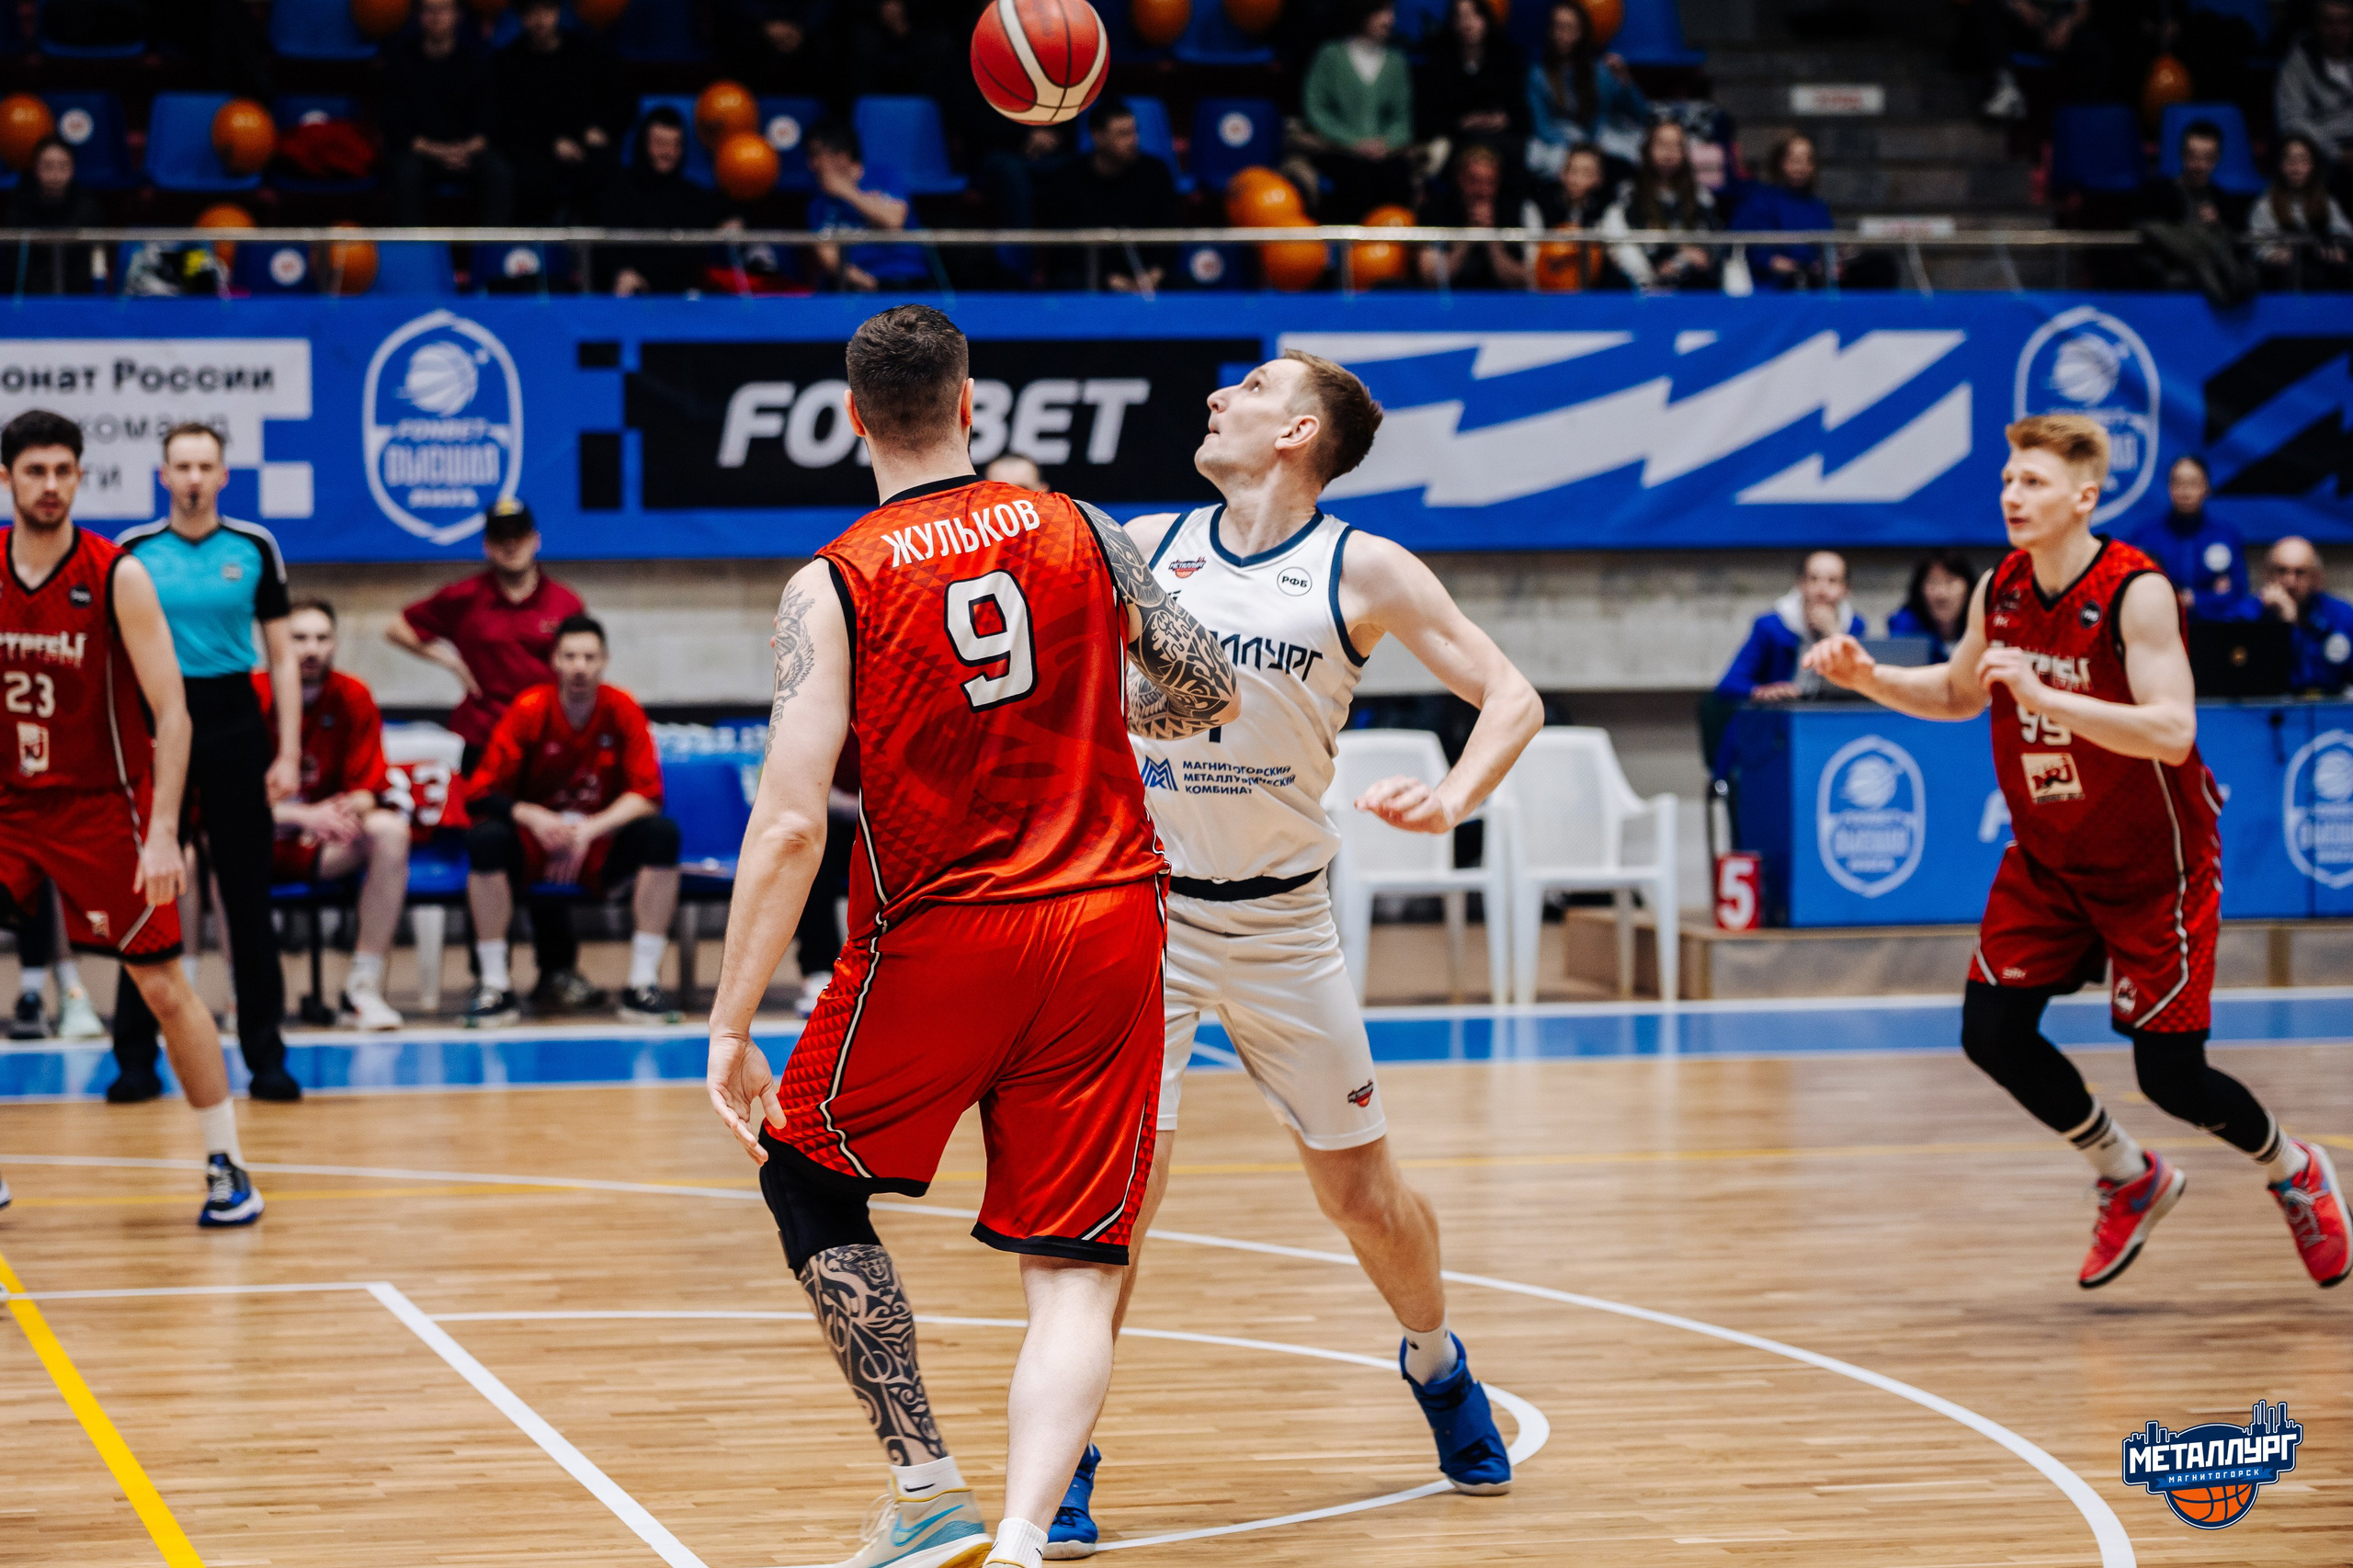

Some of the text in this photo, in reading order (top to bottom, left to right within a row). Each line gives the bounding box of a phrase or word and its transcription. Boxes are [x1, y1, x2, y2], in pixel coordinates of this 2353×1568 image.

[114, 357, 275, 394] России
[719, 378, 1151, 469] FOBET
[881, 499, 1040, 568] ЖУЛЬКОВ
[1282, 575, 1308, 588] РФБ
[943, 568, 1039, 714] 9
[1209, 630, 1324, 683] ЛЛУРГ
[4, 671, 56, 718] 23
[1186, 785, 1253, 795] КОМБИНАТ
[1718, 858, 1756, 928] 5
